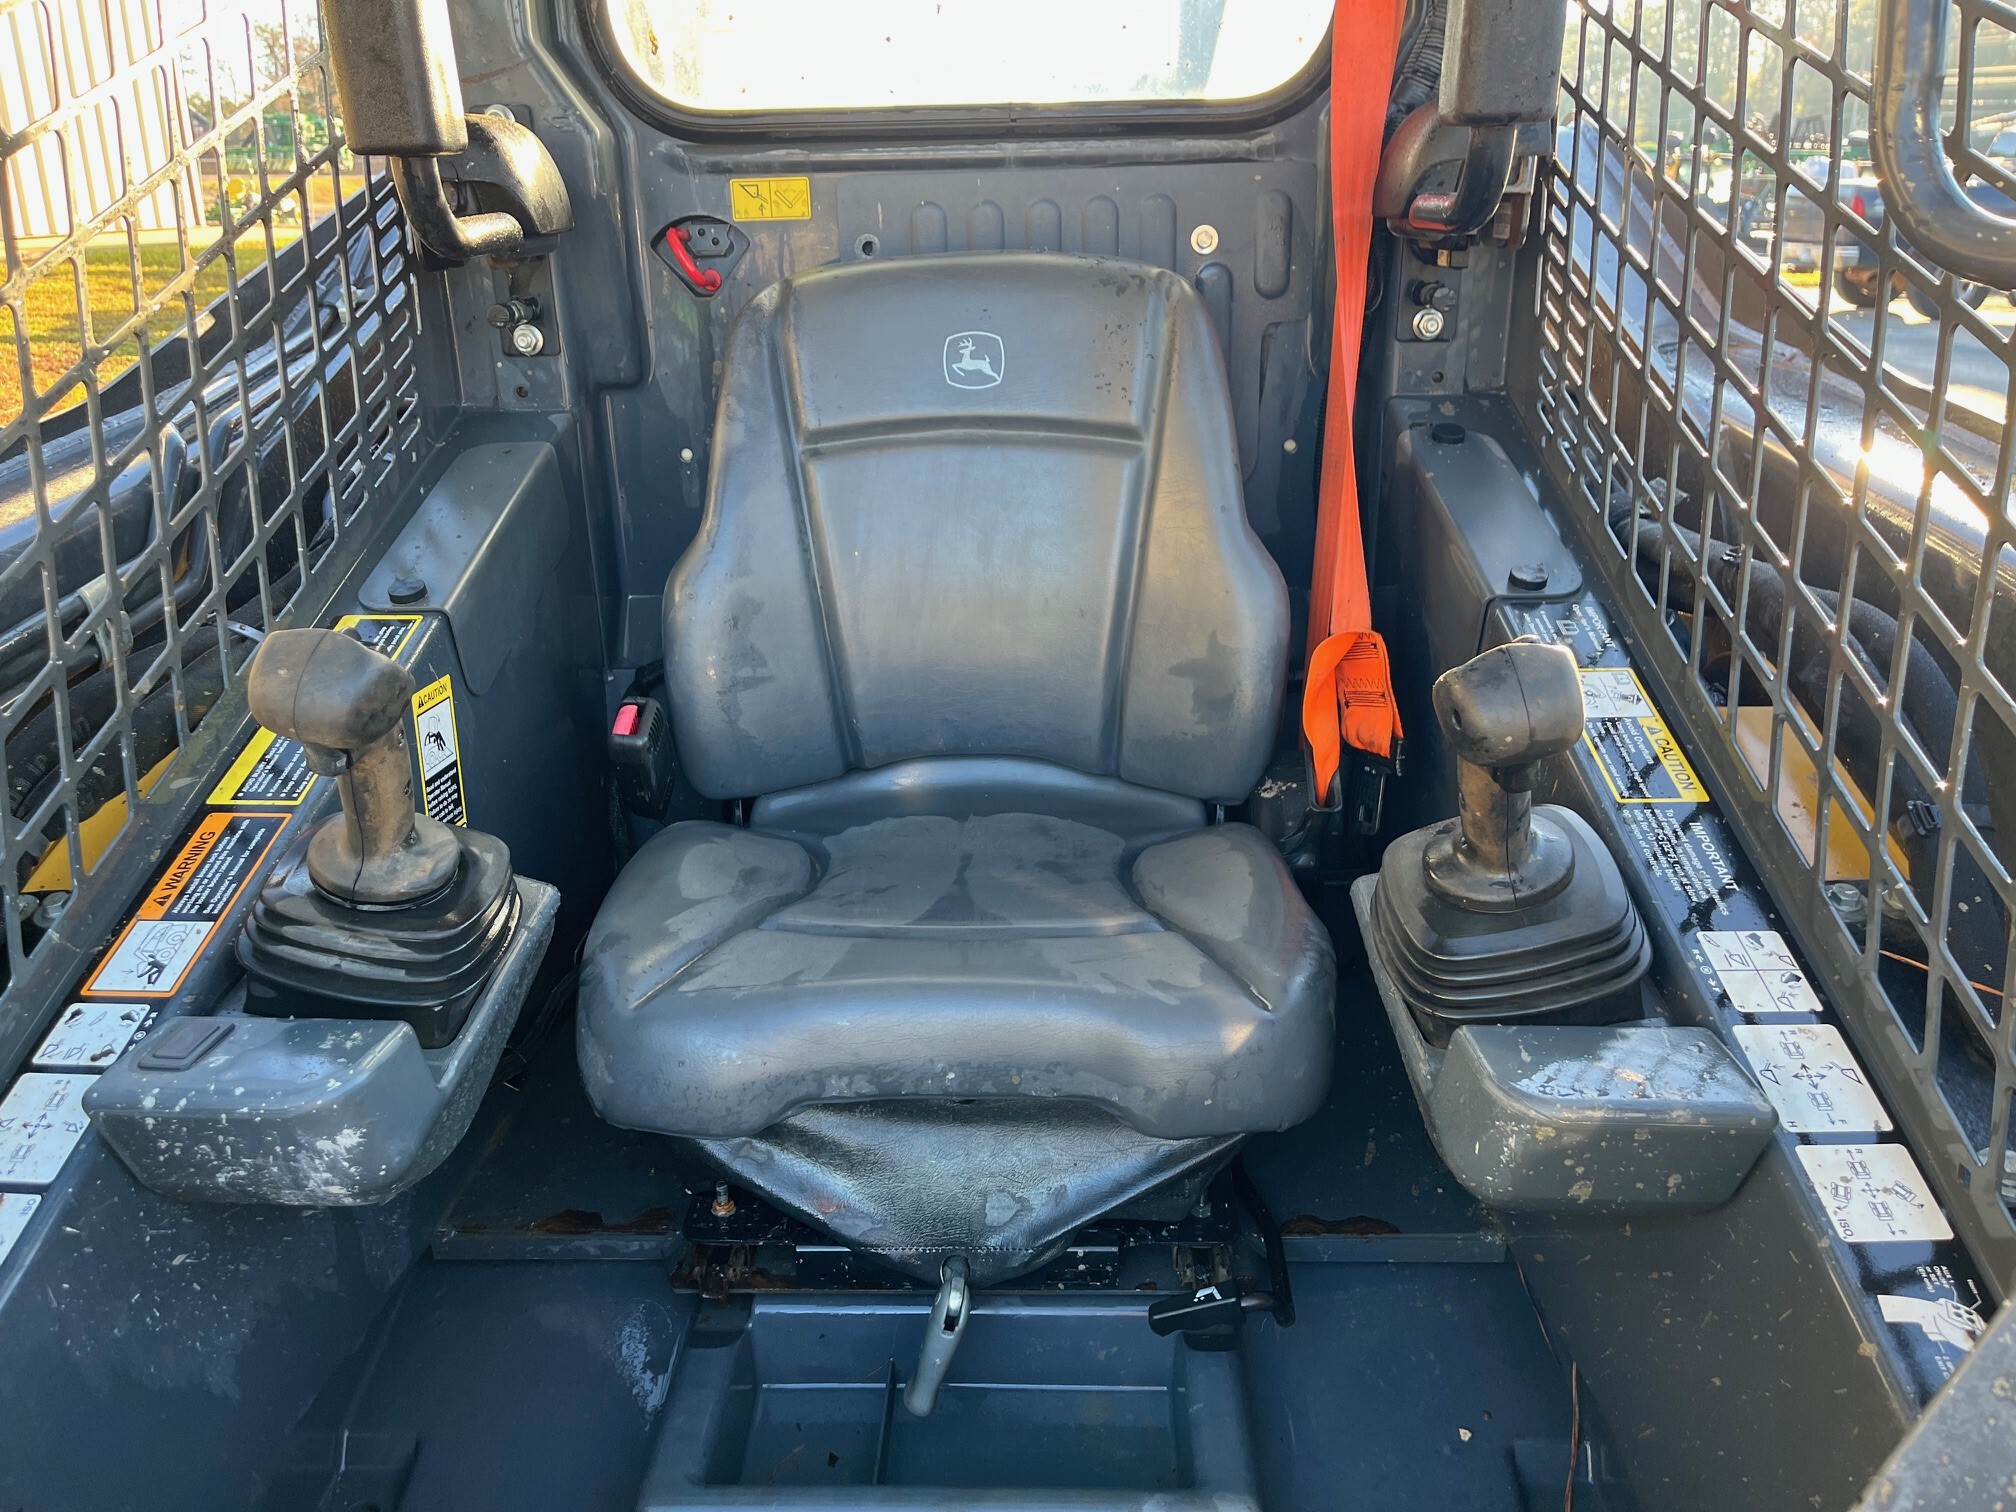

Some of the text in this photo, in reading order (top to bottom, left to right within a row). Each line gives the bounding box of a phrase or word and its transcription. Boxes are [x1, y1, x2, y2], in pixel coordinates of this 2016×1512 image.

[1585, 607, 1615, 647] IMPORTANT
[424, 683, 448, 704] CAUTION
[1623, 718, 1654, 764] Avoid Overturn
[1655, 738, 1697, 790] CAUTION
[1665, 809, 1674, 817] To
[1668, 818, 1689, 842] prevent
[162, 831, 215, 890] WARNING
[1640, 822, 1650, 831] for
[1665, 869, 1681, 891] before
[1643, 848, 1662, 877] controls.
[1644, 809, 1658, 828] below
[1673, 864, 1685, 876] run
[1685, 885, 1699, 902] slow
[1654, 809, 1667, 821] and
[1661, 822, 1677, 845] engine,
[1679, 855, 1708, 898] temperatures
[1684, 843, 1702, 869] damage
[1690, 823, 1738, 890] IMPORTANT
[1704, 879, 1729, 915] hydraulics
[20, 1198, 37, 1215] ISO
[1838, 1219, 1854, 1237] ISO
[1929, 1274, 1940, 1285] SET
